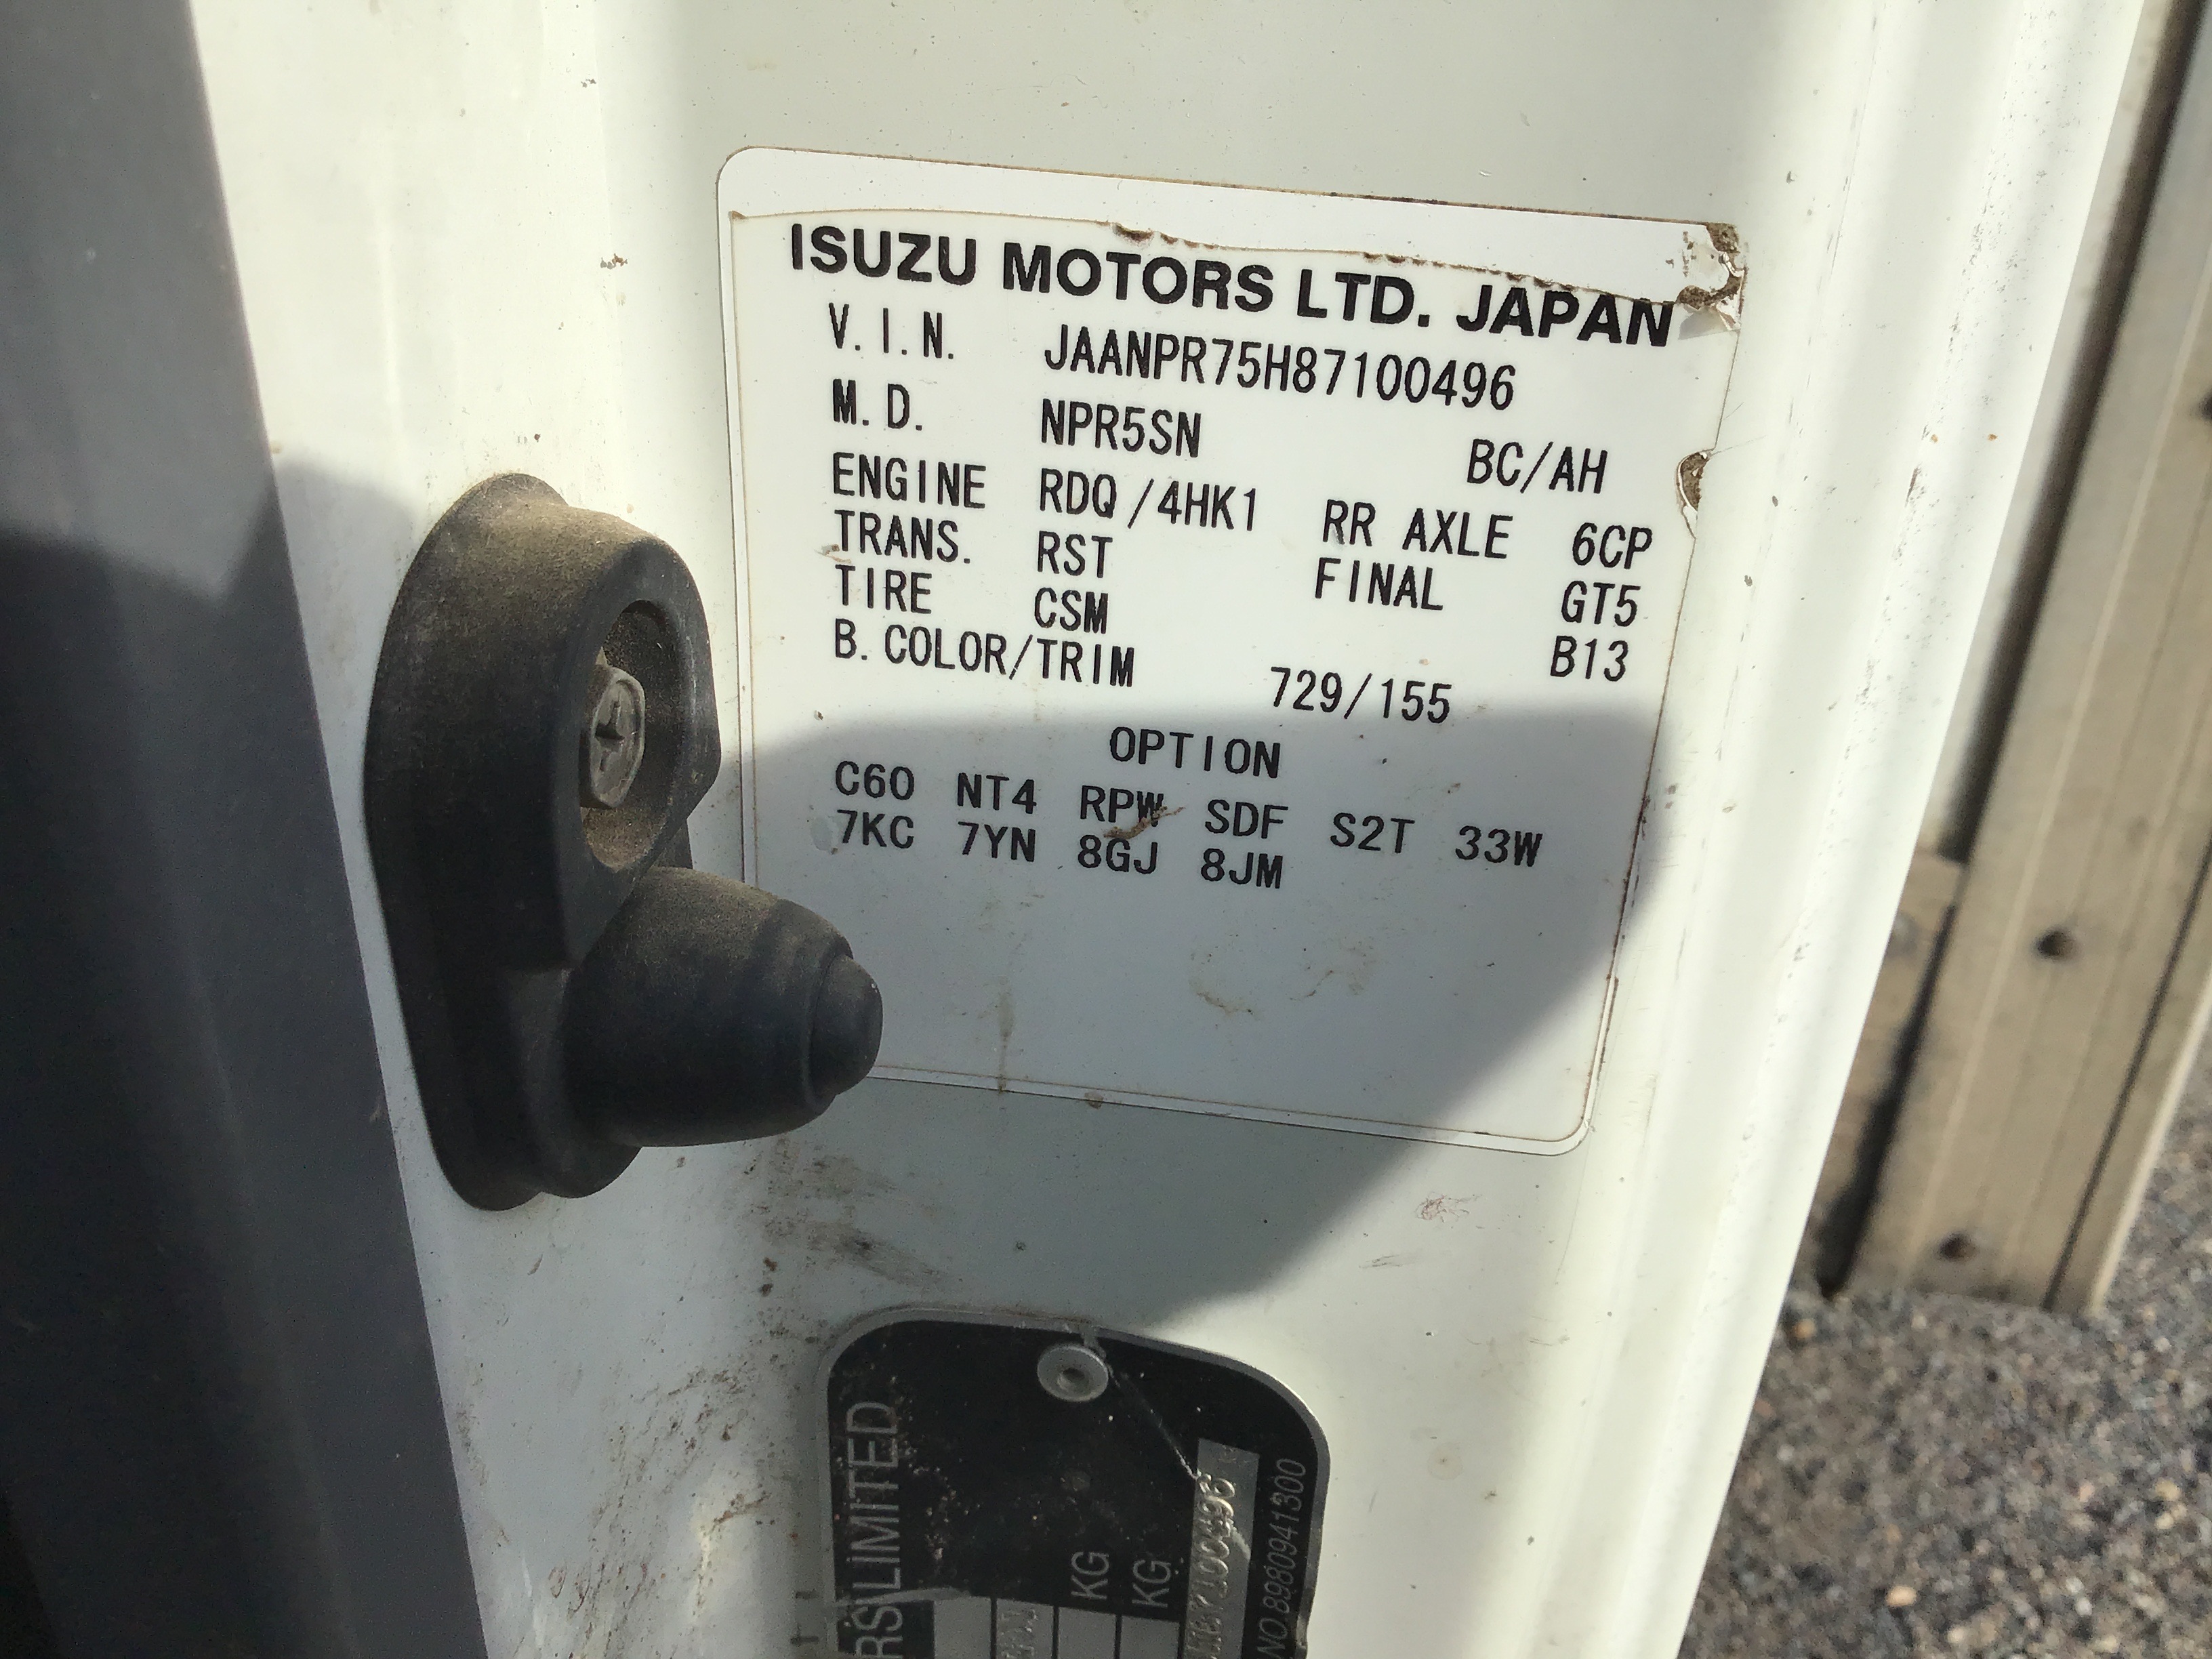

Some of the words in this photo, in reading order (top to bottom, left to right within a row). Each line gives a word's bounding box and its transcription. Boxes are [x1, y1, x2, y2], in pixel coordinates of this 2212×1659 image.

[792, 224, 976, 286] ISUZU
[1003, 243, 1273, 312] MOTORS
[1297, 268, 1430, 327] LTD.
[1456, 285, 1675, 347] JAPAN
[1044, 314, 1515, 410] JAANPR75H87100496
[1042, 398, 1201, 457] NPR5SN
[1467, 438, 1607, 493] BC/AH
[834, 452, 986, 508] ENGINE
[1323, 499, 1376, 546] RR
[1402, 508, 1513, 558] AXLE
[1572, 523, 1652, 569] 6CP
[834, 510, 970, 563] TRANS.
[1038, 531, 1113, 578] RST
[1315, 557, 1443, 611] FINAL
[1561, 581, 1641, 627] GT5
[836, 565, 932, 614] TIRE
[1034, 588, 1108, 634] CSM
[1551, 636, 1629, 682] B13
[1271, 667, 1452, 724] 729/155
[1109, 727, 1280, 778] OPTION
[836, 761, 914, 800] C60
[958, 773, 1037, 814] NT4
[1080, 785, 1164, 826] RPW
[1205, 800, 1288, 839] SDF
[1330, 813, 1415, 854] S2T
[1456, 825, 1542, 867] 33W
[837, 810, 914, 848] 7KC
[958, 821, 1036, 862] 7YN
[1078, 835, 1158, 874] 8GJ
[1201, 848, 1283, 888] 8JM
[848, 1401, 901, 1590] LIMITED
[1071, 1552, 1110, 1600] KG
[1132, 1560, 1172, 1607] KG
